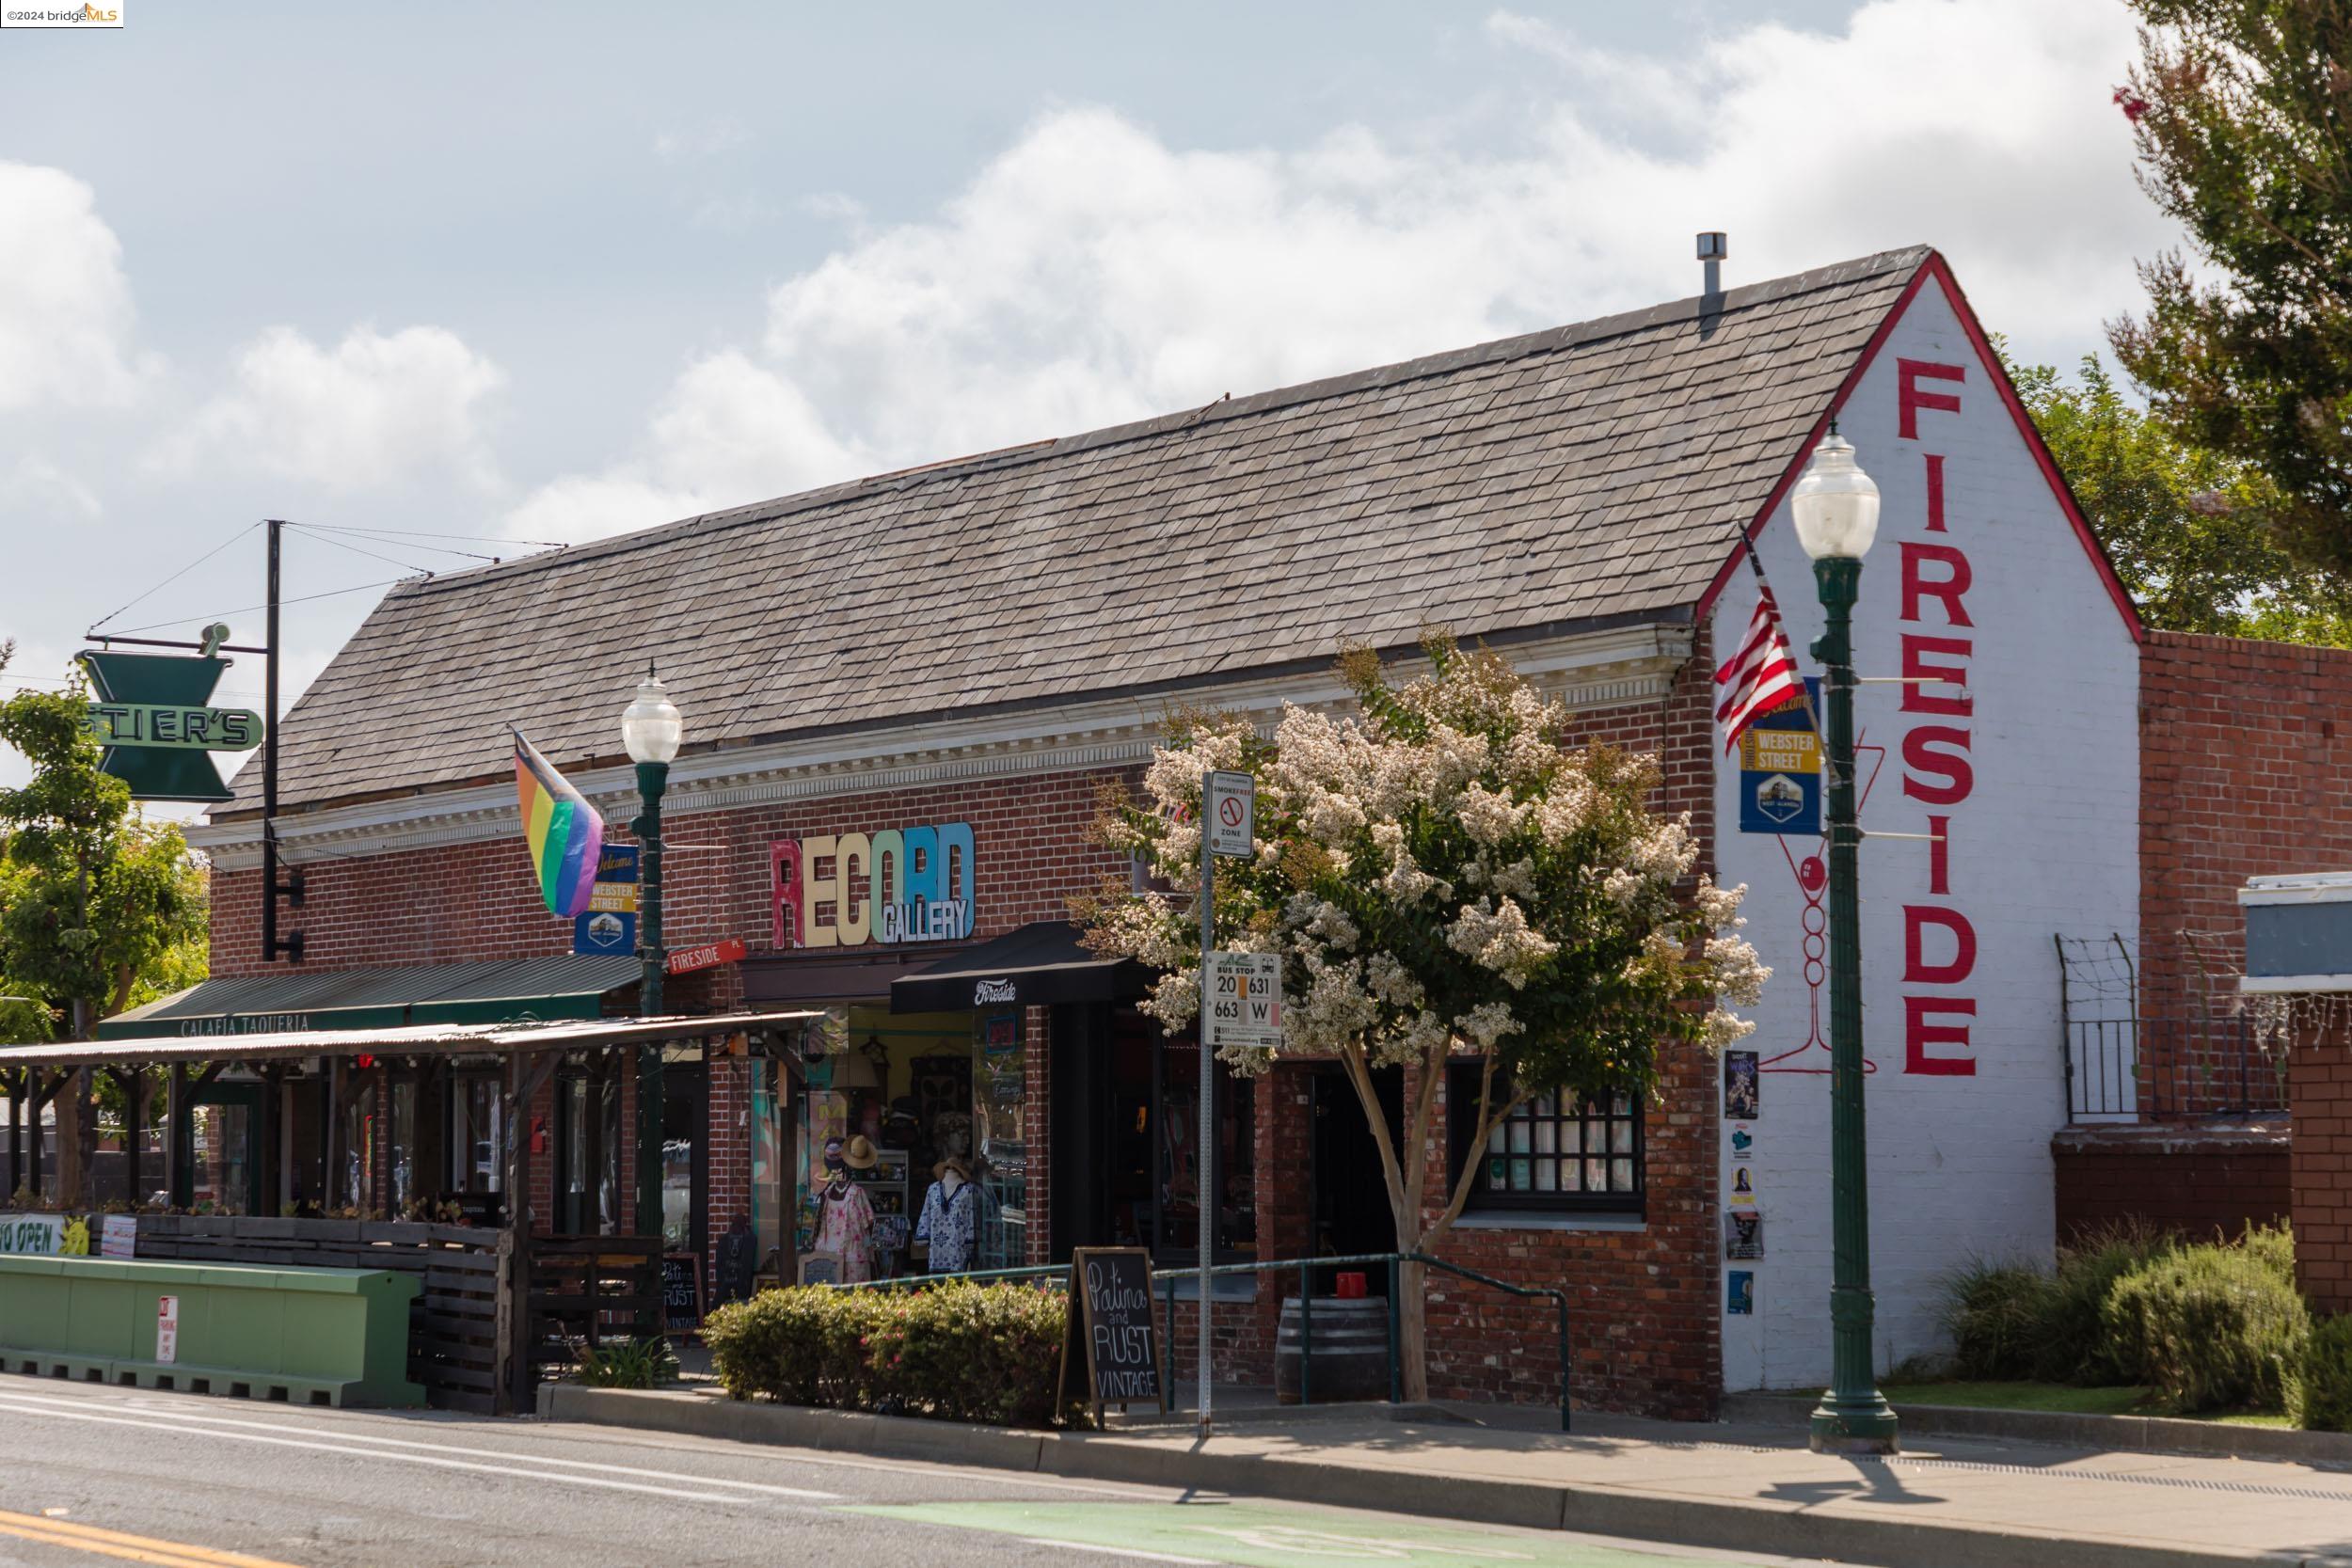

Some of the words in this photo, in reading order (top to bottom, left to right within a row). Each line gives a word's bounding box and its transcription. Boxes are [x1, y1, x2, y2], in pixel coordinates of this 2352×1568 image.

[1896, 356, 1977, 1077] FIRESIDE
[1758, 733, 1815, 751] WEBSTER
[1758, 752, 1803, 769] STREET
[1220, 829, 1242, 837] ZONE
[592, 885, 632, 896] WEBSTER
[770, 821, 976, 950] RECORD
[591, 898, 625, 910] STREET
[882, 900, 967, 944] GALLERY
[671, 946, 721, 972] FIRESIDE
[975, 978, 1016, 1006] Fireside
[1217, 975, 1237, 993] 20
[1248, 977, 1269, 994] 631
[1215, 1001, 1238, 1018] 663
[1251, 1003, 1268, 1020] W
[181, 1018, 235, 1037] CALAFIA
[242, 1015, 309, 1035] TAQUERIA
[17, 1222, 53, 1252] OPEN
[1088, 1260, 1148, 1311] Patina
[663, 1289, 695, 1306] RUST
[1109, 1311, 1130, 1325] and
[1093, 1324, 1152, 1364] RUST
[1097, 1370, 1158, 1399] VINTAGE
